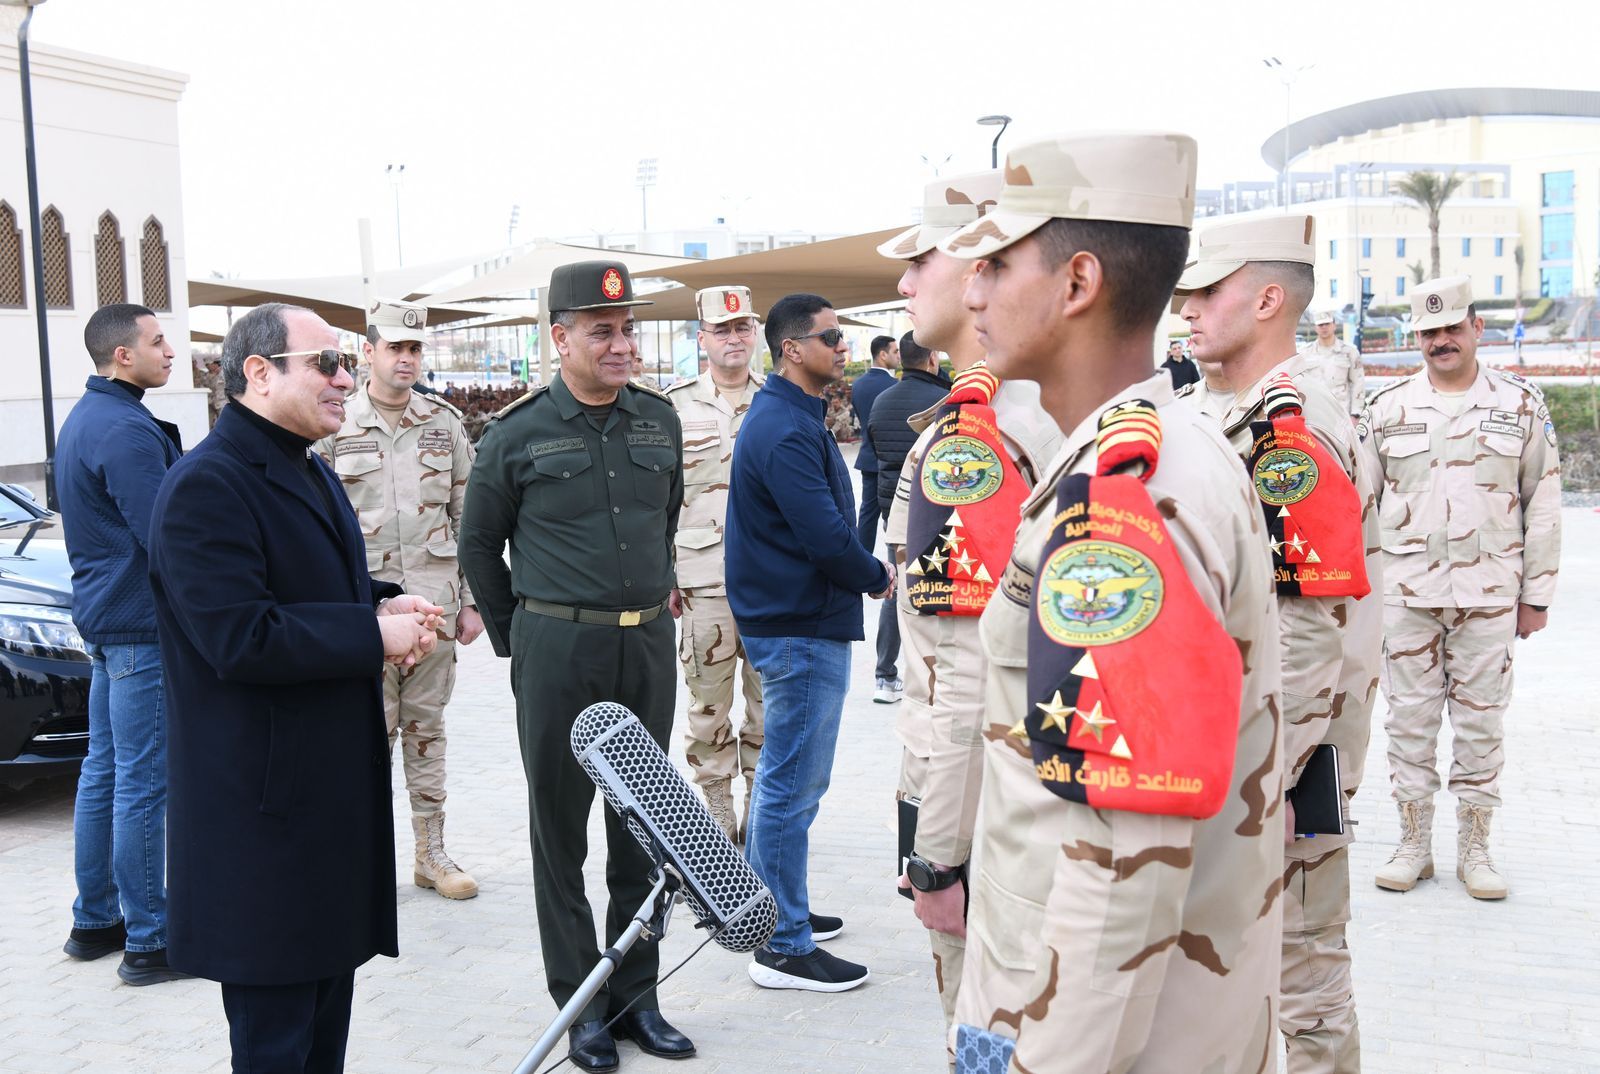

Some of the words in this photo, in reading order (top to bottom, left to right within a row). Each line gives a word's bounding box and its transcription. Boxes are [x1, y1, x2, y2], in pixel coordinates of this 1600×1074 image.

[1065, 521, 1123, 538] المصرية
[1087, 501, 1164, 545] الأكاديمية
[1293, 567, 1320, 585] كاتب
[1322, 567, 1352, 581] مساعد
[930, 580, 959, 595] ممتاز
[1066, 631, 1116, 640] MILITARY
[1075, 759, 1132, 793] قارئ
[1136, 770, 1204, 794] مساعد
